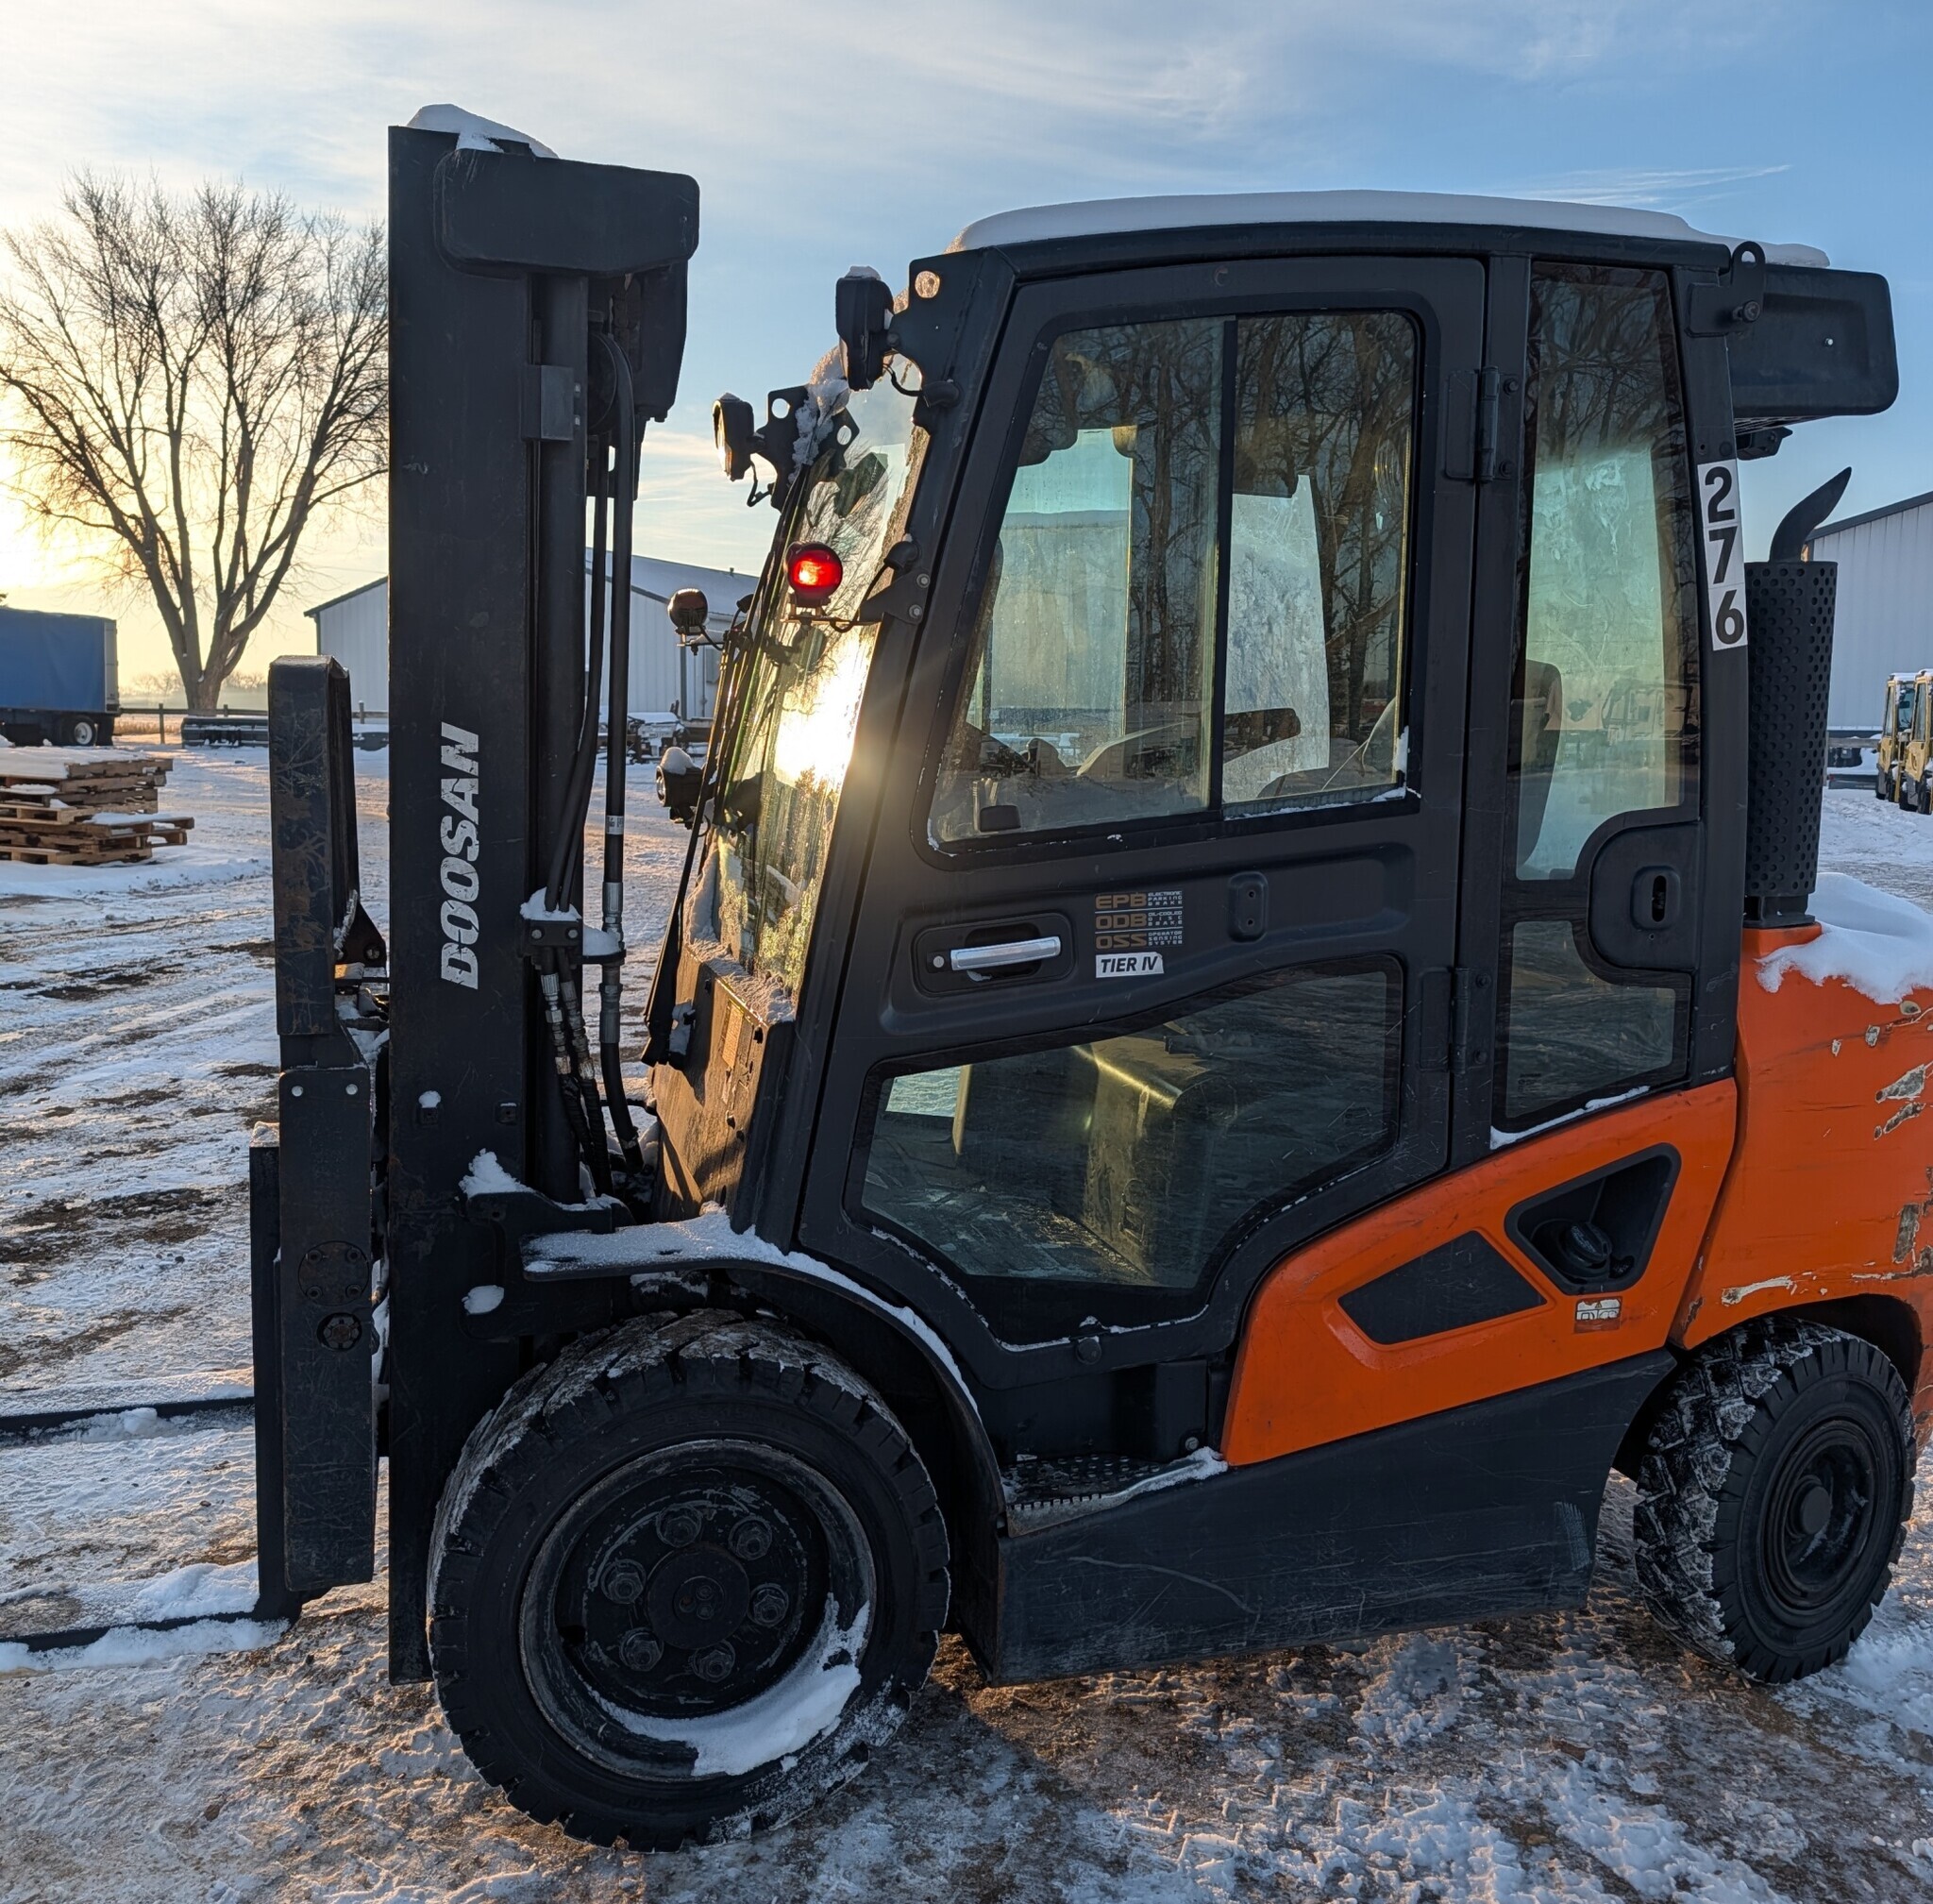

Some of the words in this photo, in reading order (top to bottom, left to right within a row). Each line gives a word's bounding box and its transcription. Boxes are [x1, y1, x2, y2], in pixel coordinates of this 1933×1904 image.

[1705, 465, 1745, 645] 276
[440, 721, 479, 989] DOOSAN
[1096, 893, 1148, 909] EPB
[1096, 913, 1148, 929] ODB
[1096, 933, 1148, 950] OSS
[1101, 957, 1137, 973] TIER
[1141, 955, 1159, 971] IV
